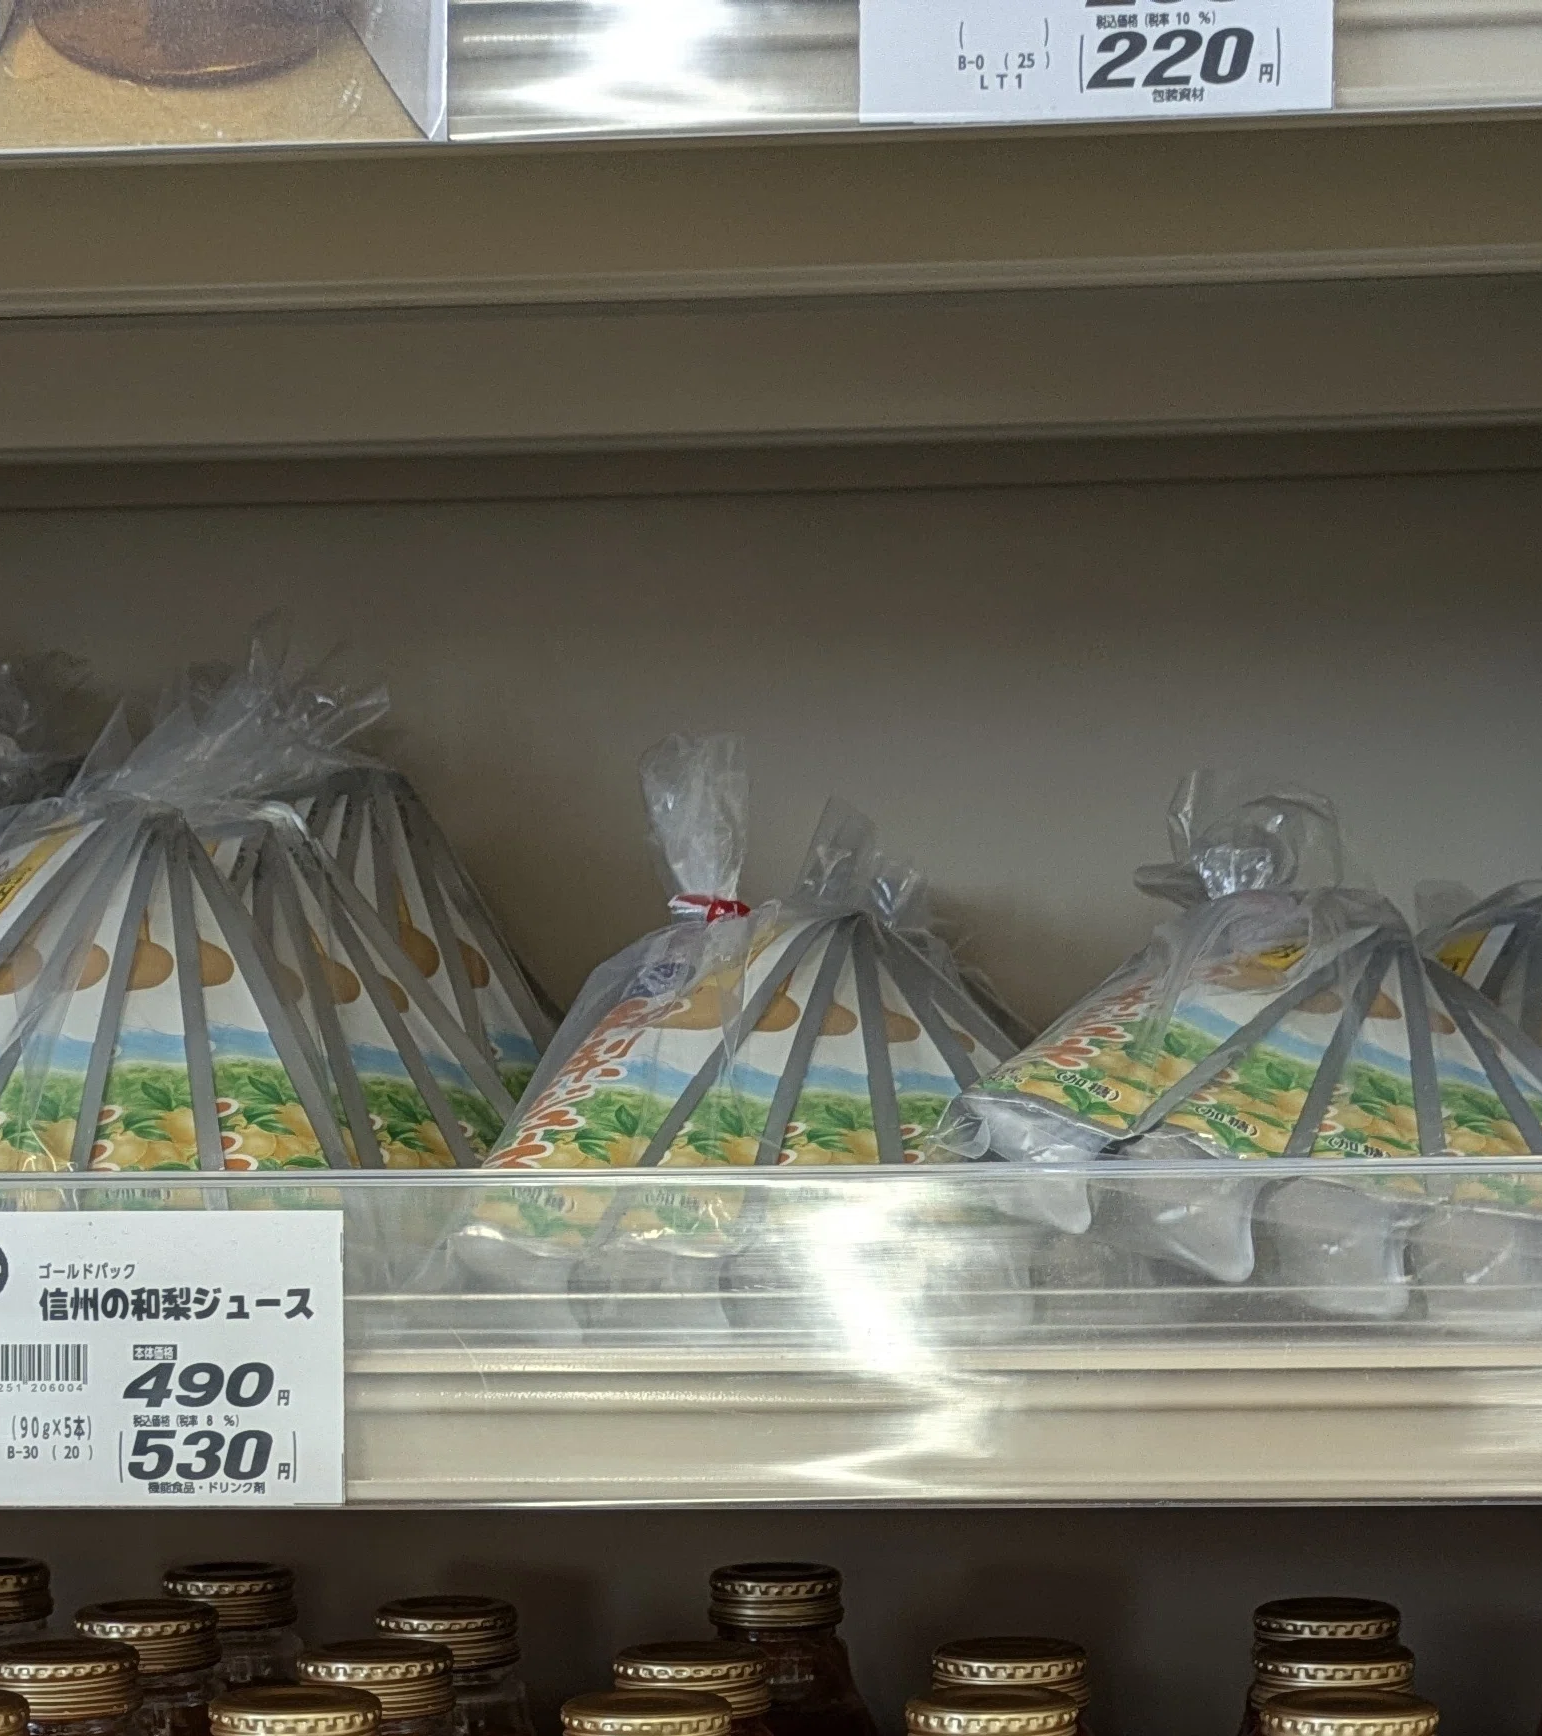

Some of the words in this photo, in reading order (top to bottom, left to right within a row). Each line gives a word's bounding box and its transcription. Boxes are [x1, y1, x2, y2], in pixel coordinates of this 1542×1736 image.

[38, 1263, 135, 1280] ゴールドパック
[39, 1287, 314, 1321] 信州の和梨ジュース
[134, 1346, 176, 1360] 本体価格
[133, 1415, 170, 1427] 税込価格
[148, 1482, 266, 1495] 機能食品・ドリンク剤
